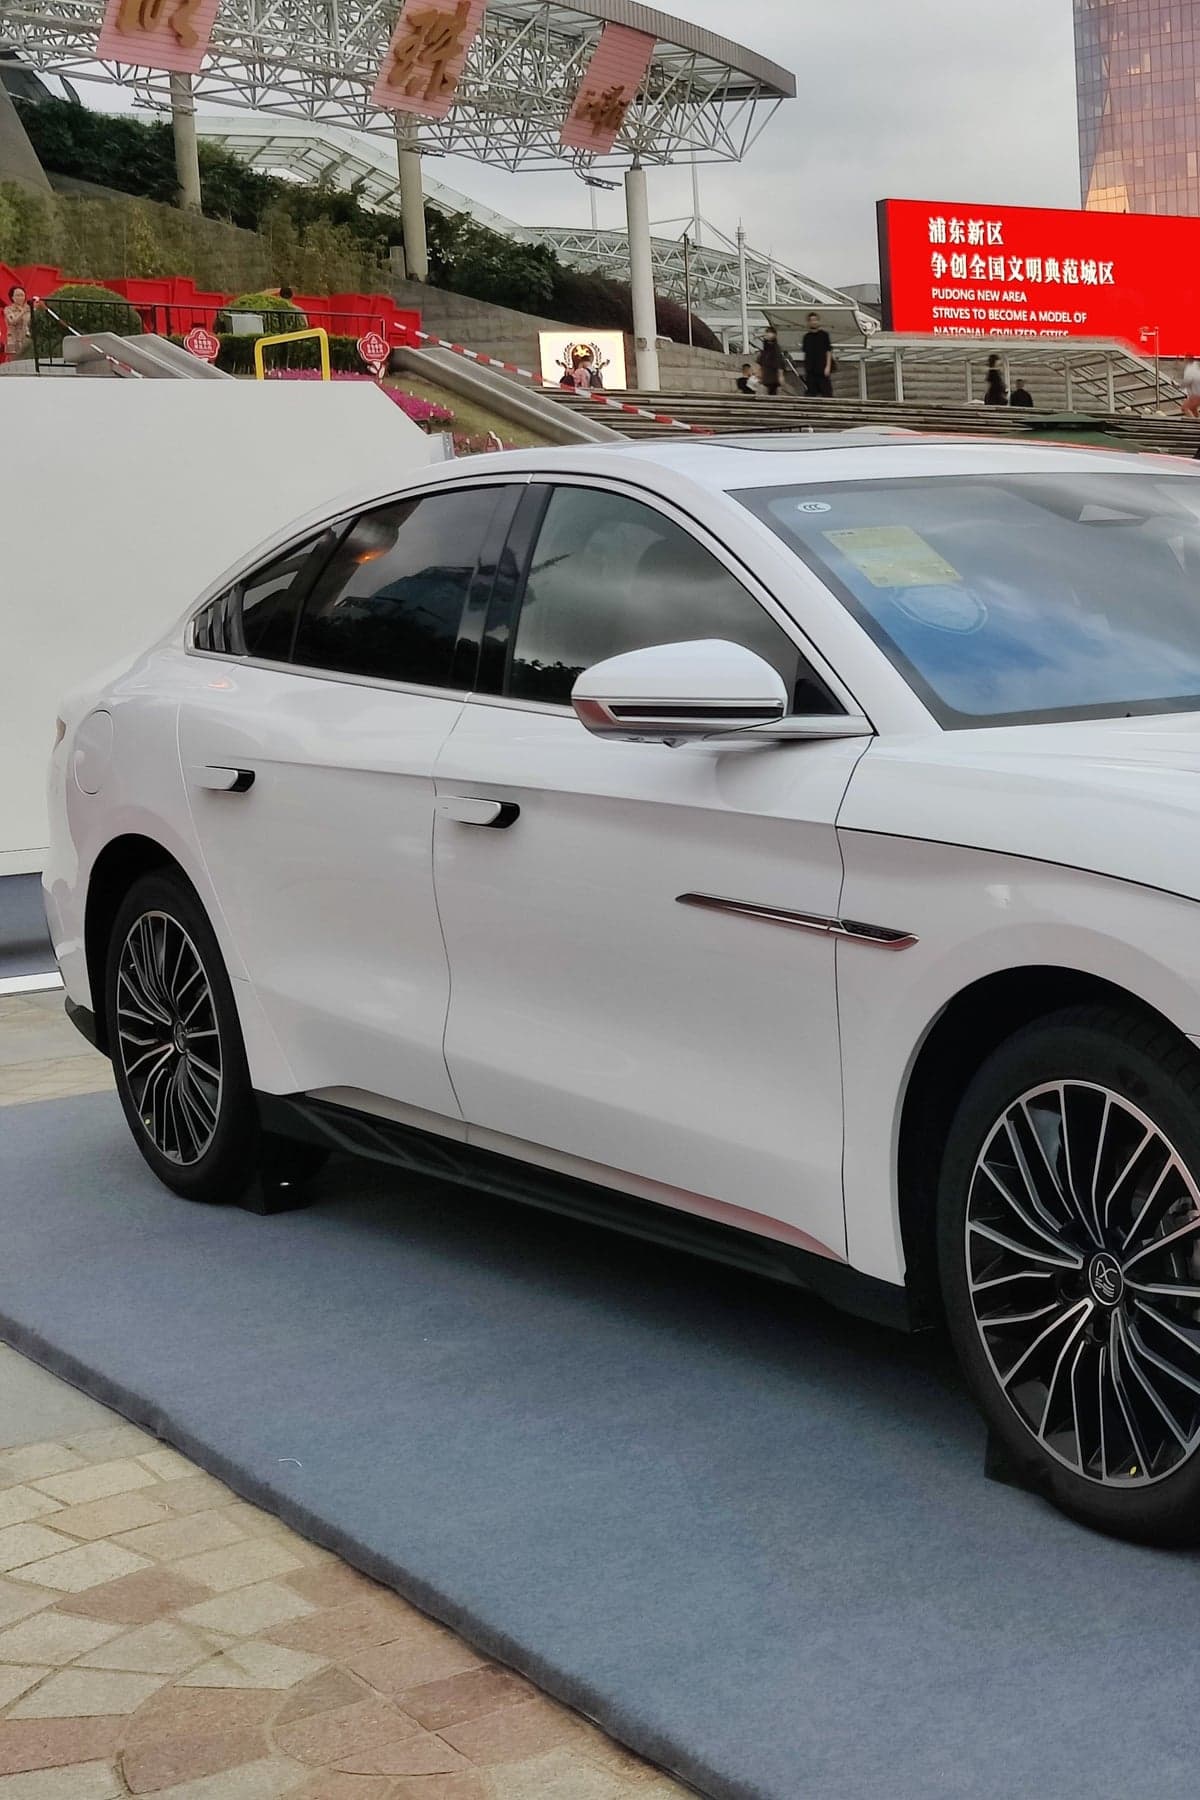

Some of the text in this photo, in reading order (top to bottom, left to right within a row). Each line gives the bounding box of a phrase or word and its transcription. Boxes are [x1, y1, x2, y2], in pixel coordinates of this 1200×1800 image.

[928, 217, 1004, 245] 浦东新区
[930, 252, 1115, 285] 争创全国文明典范城区
[932, 288, 1027, 303] PUDONG NEW AREA
[932, 307, 1087, 323] STRIVES TO BECOME A MODEL OF
